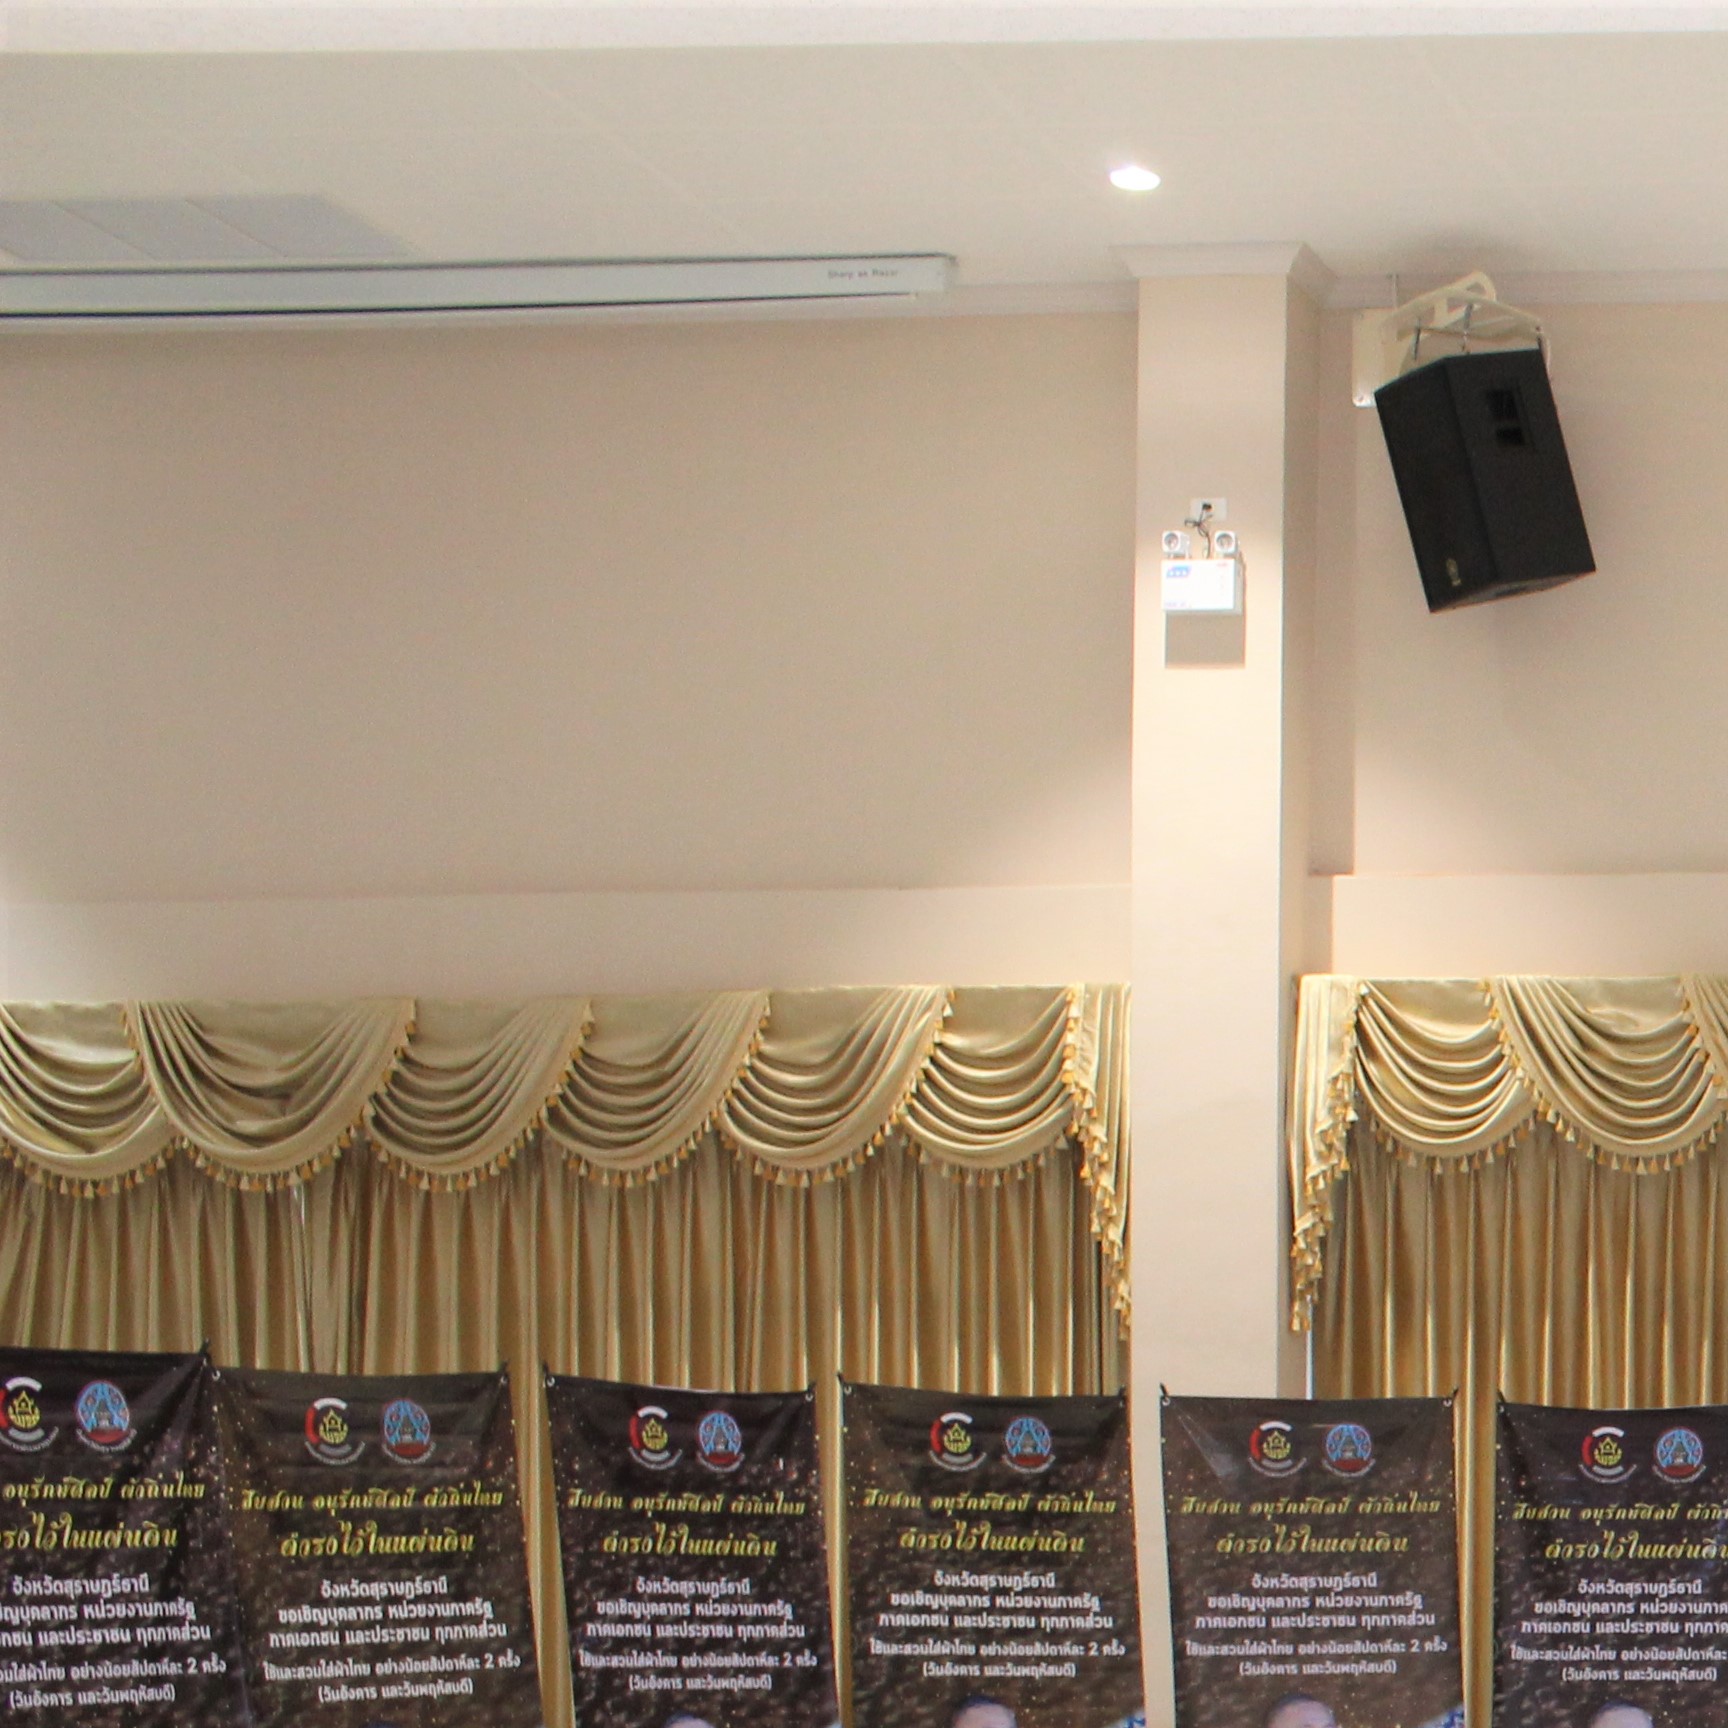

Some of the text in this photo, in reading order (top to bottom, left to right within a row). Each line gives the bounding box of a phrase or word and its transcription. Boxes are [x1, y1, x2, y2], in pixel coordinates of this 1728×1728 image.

[13, 1573, 148, 1601] จังหวัดสุราษฎร์ธานี
[321, 1576, 447, 1604] จังหวัดสุราษฎร์ธานี
[934, 1571, 1056, 1593] จังหวัดสุราษฎร์ธานี
[1578, 1580, 1702, 1601] จังหวัดสุราษฎร์ธานี
[877, 1614, 948, 1628] ภาคเอกชน
[1520, 1622, 1590, 1635] ภาคเอกชน
[267, 1631, 341, 1648] ภาคเอกชน
[1409, 1640, 1420, 1654] 2
[1088, 1642, 1098, 1656] 2
[186, 1657, 198, 1674] 2
[483, 1654, 495, 1670] 2
[782, 1653, 792, 1668] 2
